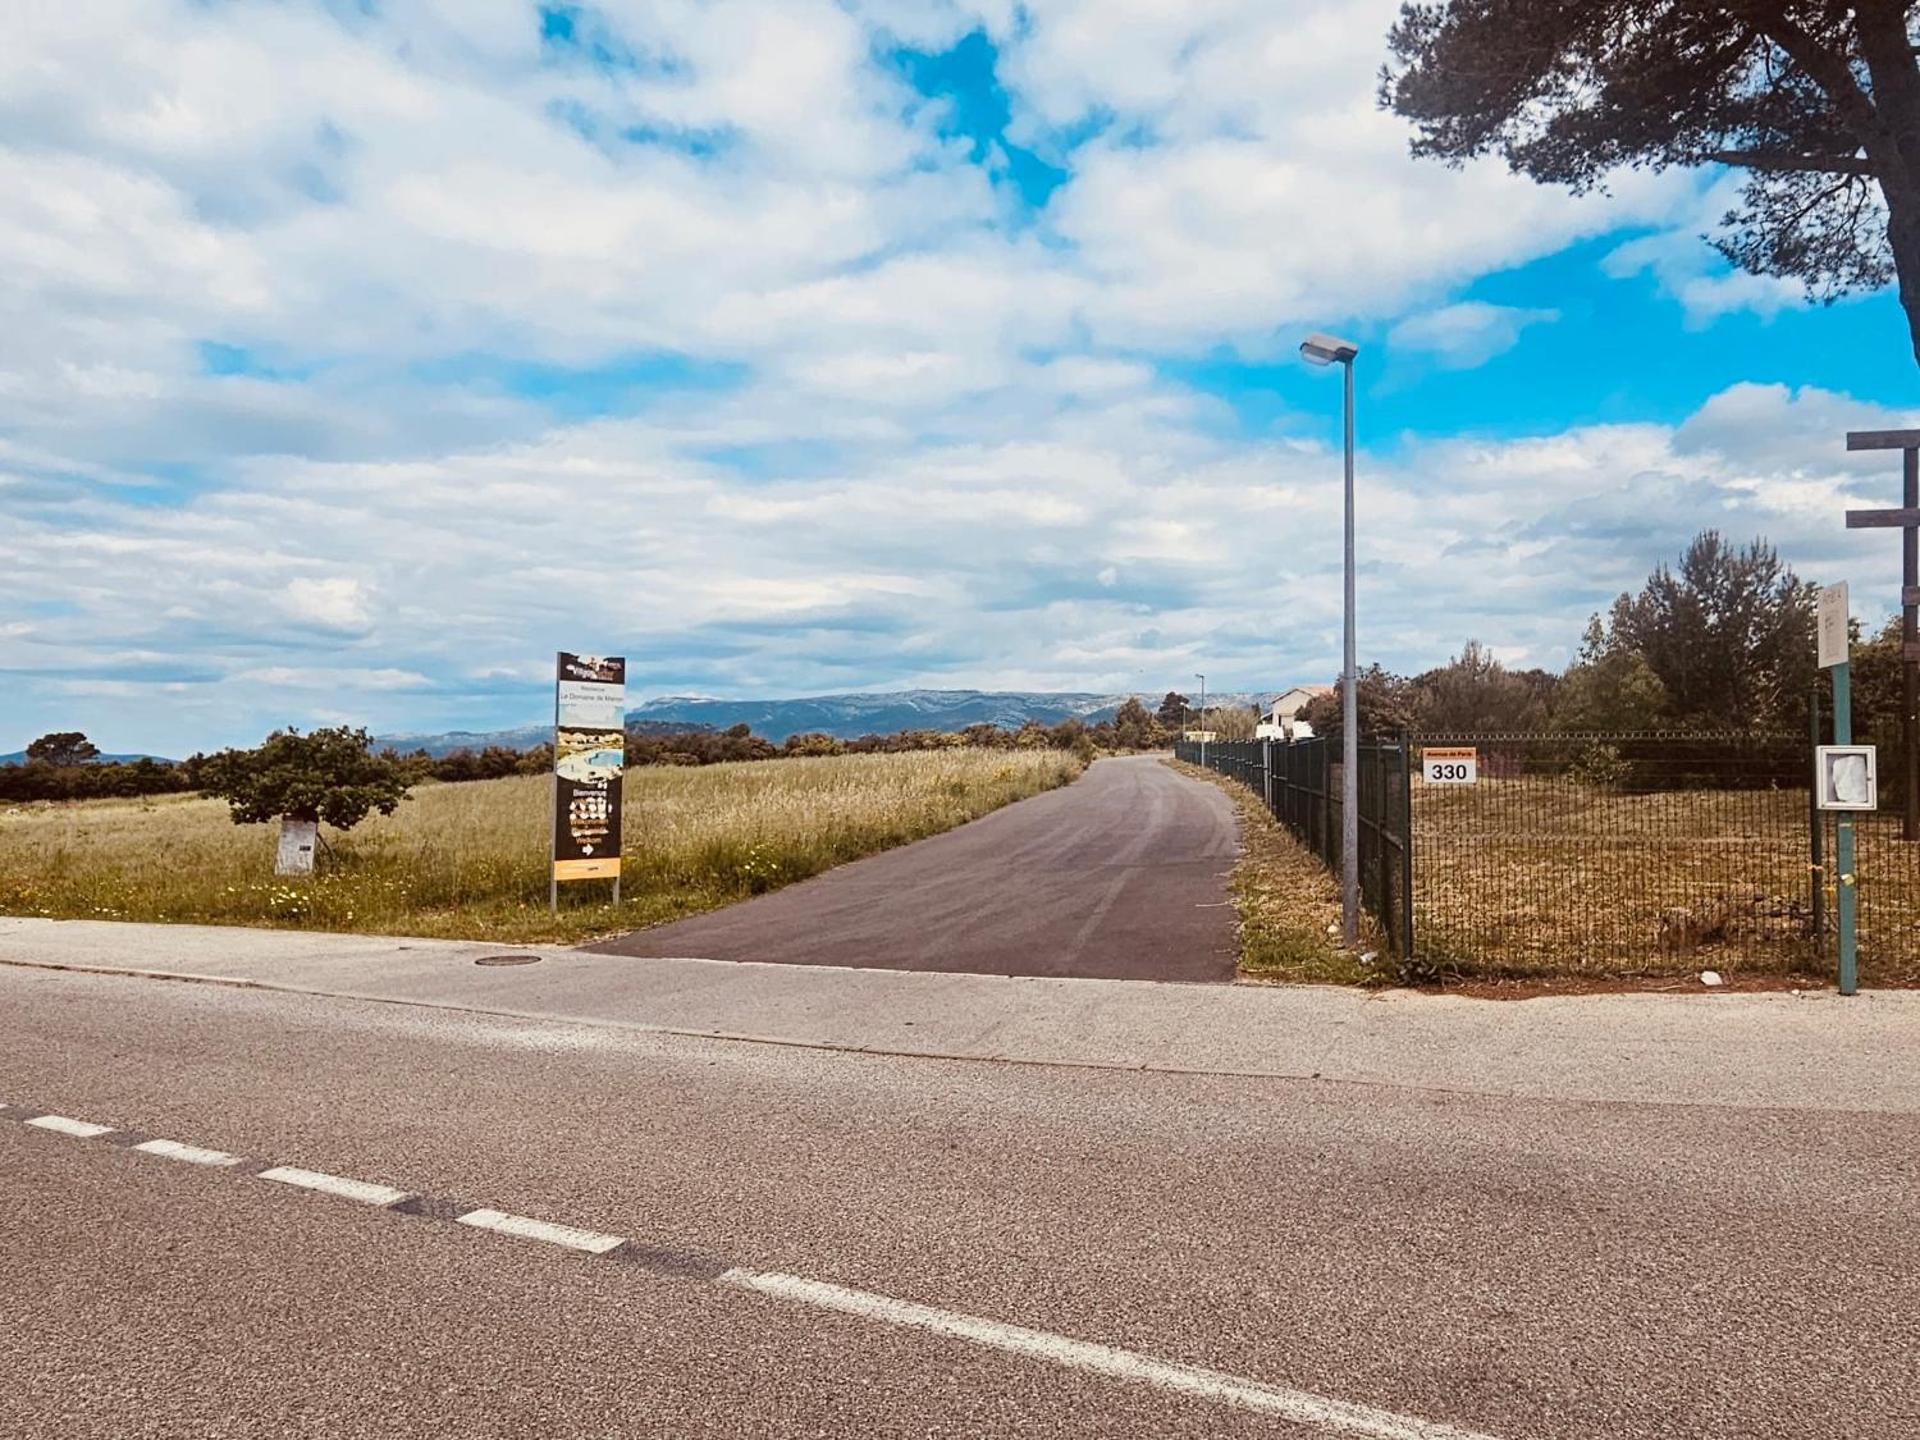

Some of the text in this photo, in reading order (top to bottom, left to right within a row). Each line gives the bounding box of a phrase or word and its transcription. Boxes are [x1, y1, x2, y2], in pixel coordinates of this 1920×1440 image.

[569, 693, 594, 701] Domaine
[1432, 764, 1467, 780] 330
[573, 789, 607, 797] Bienvenue
